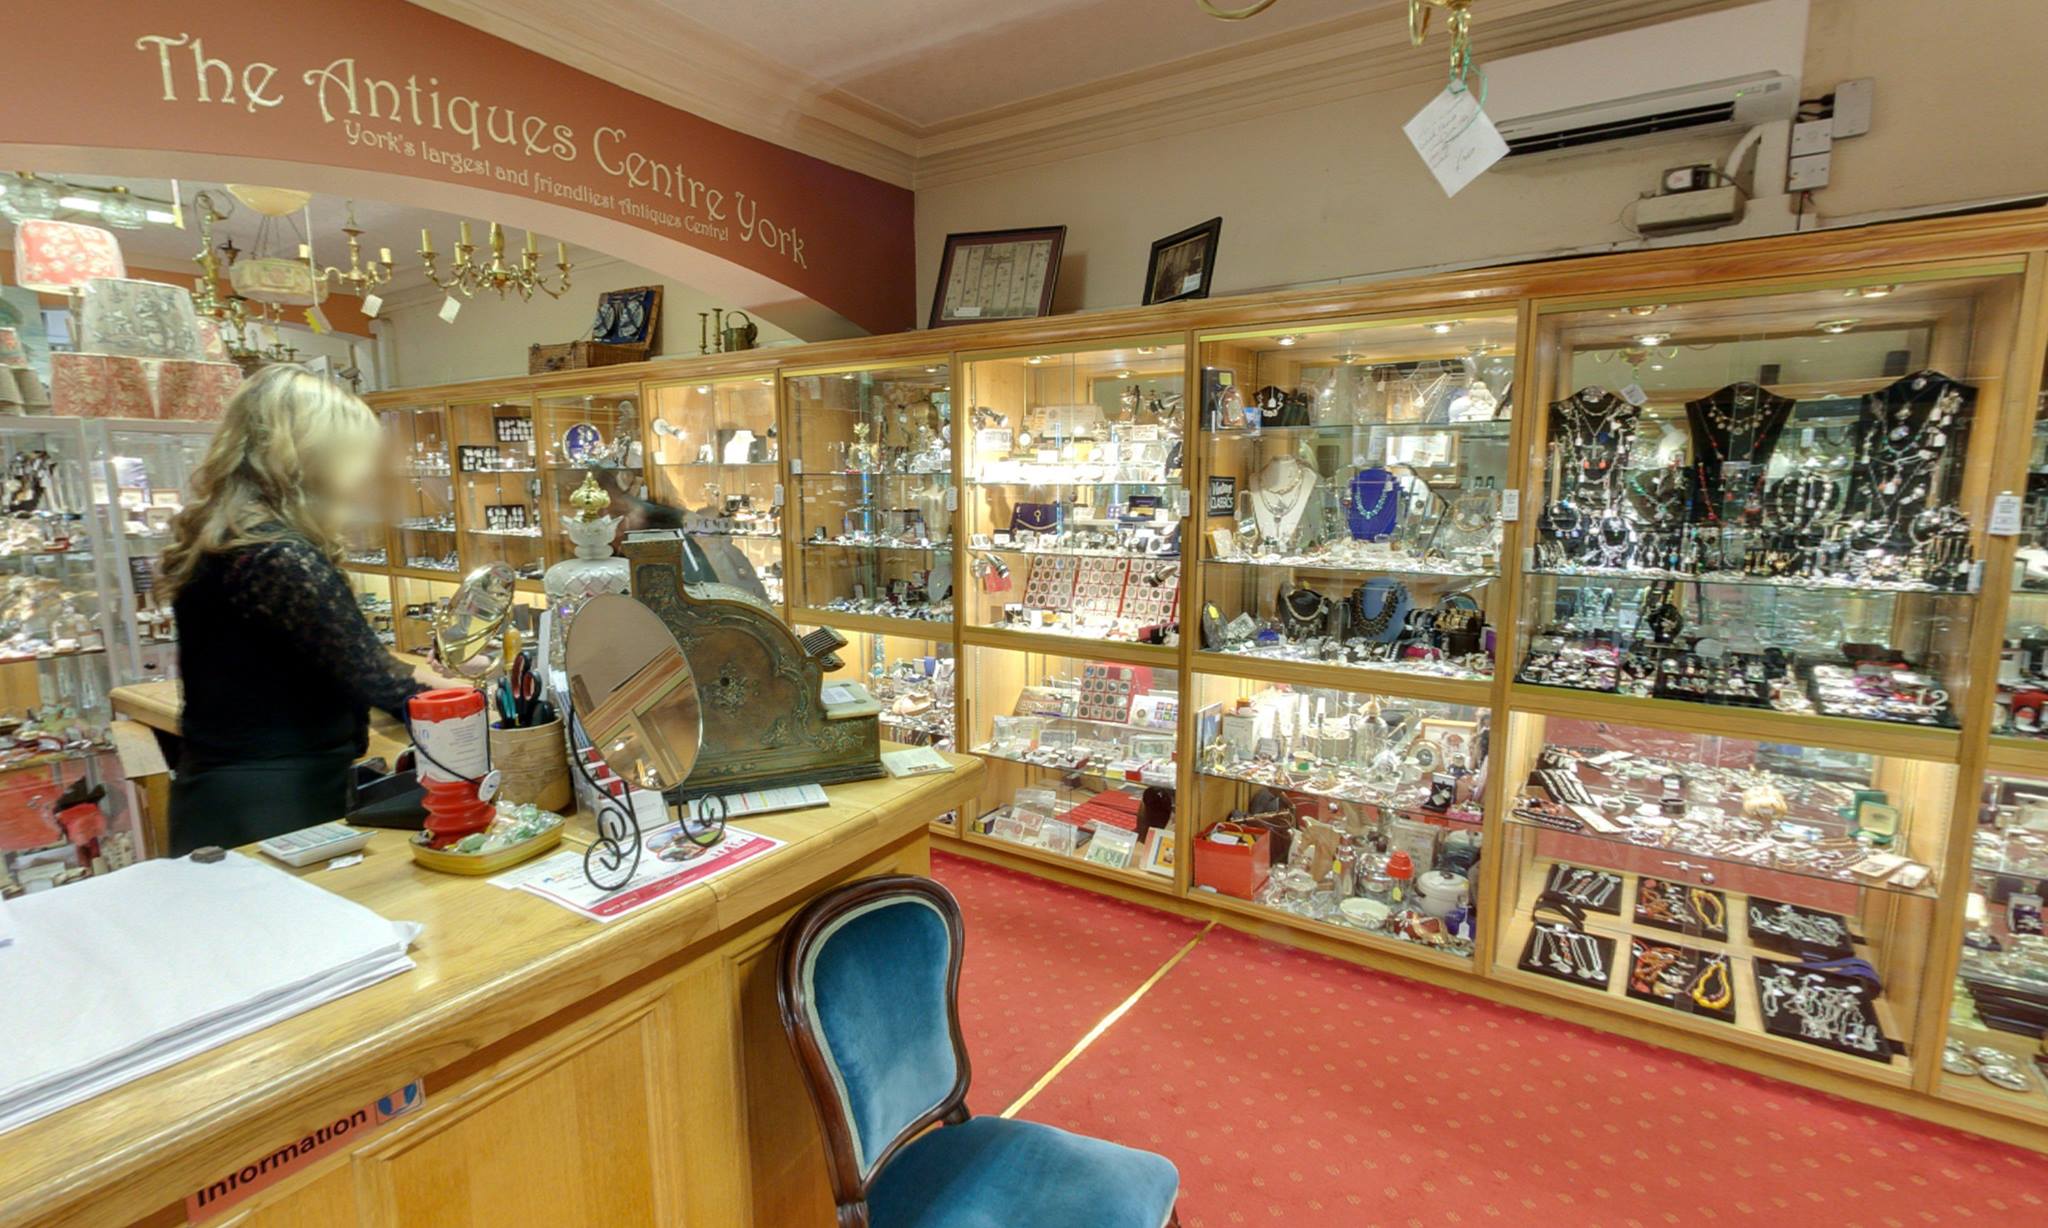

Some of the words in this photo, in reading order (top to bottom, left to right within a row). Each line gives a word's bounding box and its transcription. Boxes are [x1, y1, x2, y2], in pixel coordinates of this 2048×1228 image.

[135, 32, 285, 113] The
[303, 58, 577, 161] Antiques
[593, 126, 726, 221] Centre
[736, 191, 807, 269] York
[344, 119, 417, 156] York's
[422, 141, 491, 174] largest
[496, 166, 529, 186] and
[533, 172, 615, 209] friendliest
[618, 198, 682, 229] Antiques
[196, 1108, 367, 1208] Information
